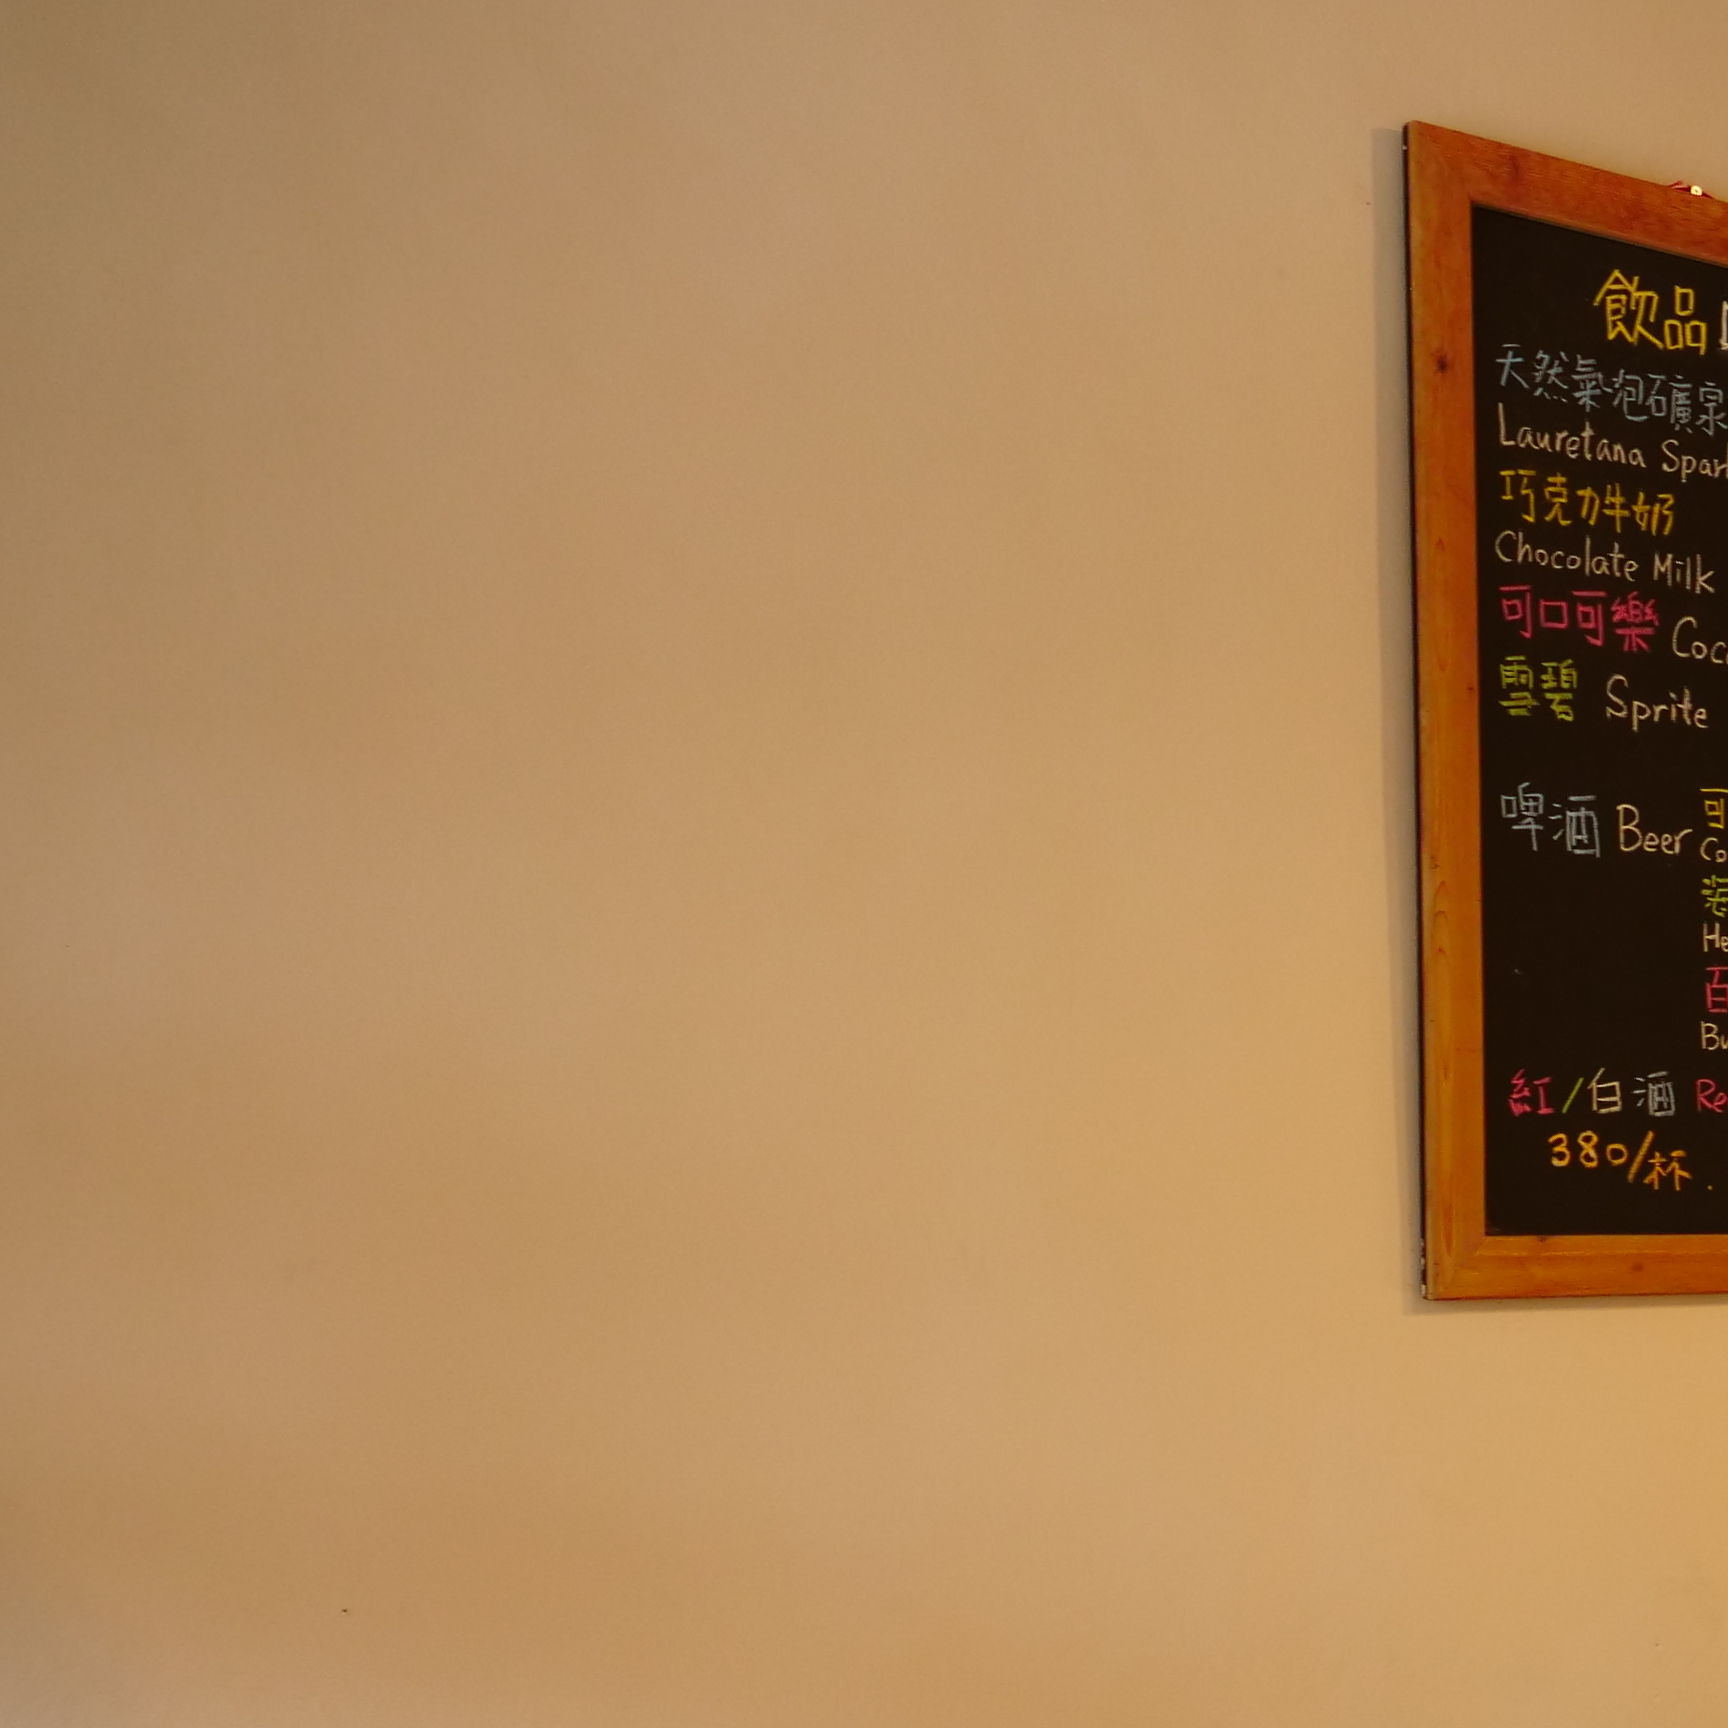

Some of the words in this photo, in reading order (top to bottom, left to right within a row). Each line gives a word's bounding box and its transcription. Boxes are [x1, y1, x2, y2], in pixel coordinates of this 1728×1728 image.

[1594, 269, 1707, 355] 飲品
[1498, 402, 1646, 469] Lauretana
[1500, 469, 1676, 536] 巧克力牛奶
[1495, 529, 1640, 582] Chocolate
[1653, 550, 1715, 595] Milk
[1499, 584, 1660, 653] 可口可樂
[1498, 655, 1578, 722] 雪碧
[1605, 673, 1709, 733] Sprite
[1500, 781, 1600, 859] 啤酒
[1616, 803, 1693, 855] Beer
